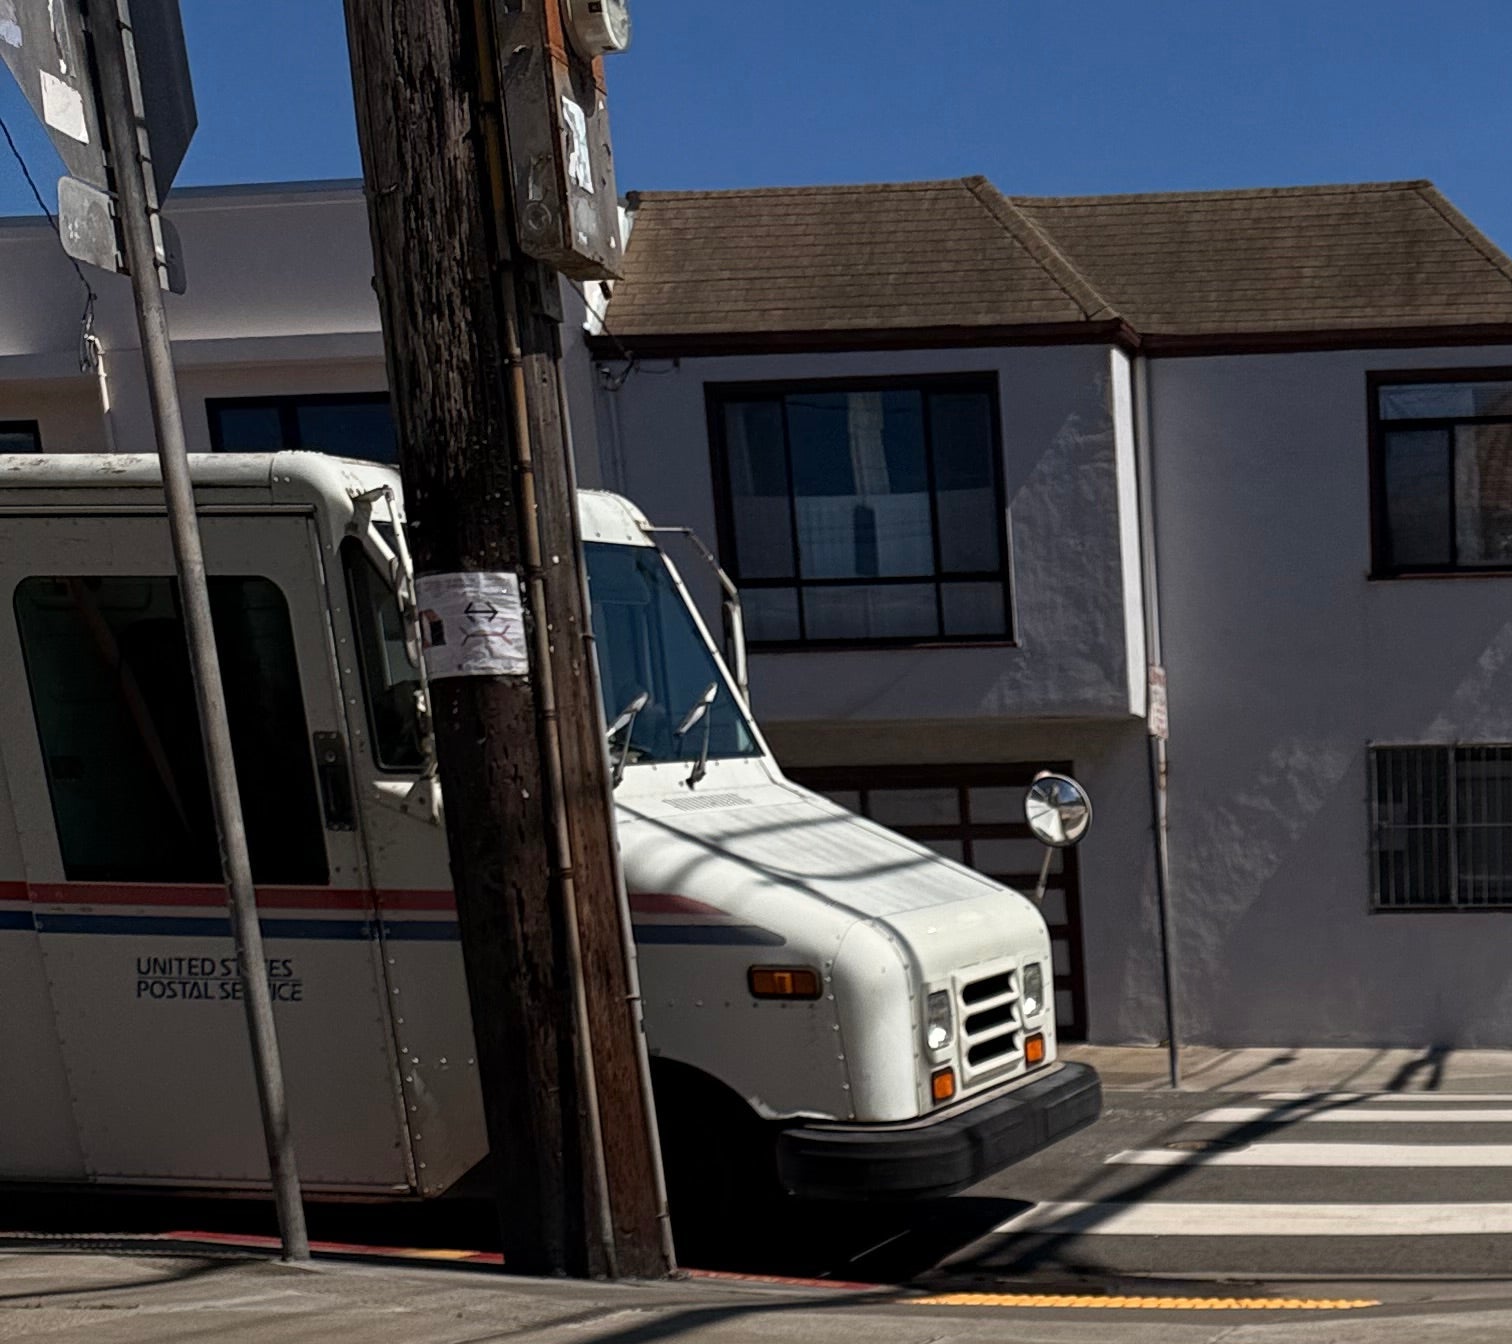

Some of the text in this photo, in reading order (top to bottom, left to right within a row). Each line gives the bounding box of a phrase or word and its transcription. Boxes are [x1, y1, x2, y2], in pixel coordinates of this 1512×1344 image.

[137, 957, 293, 977] UNITED STES
[136, 980, 303, 1001] POSTAL SEICE
